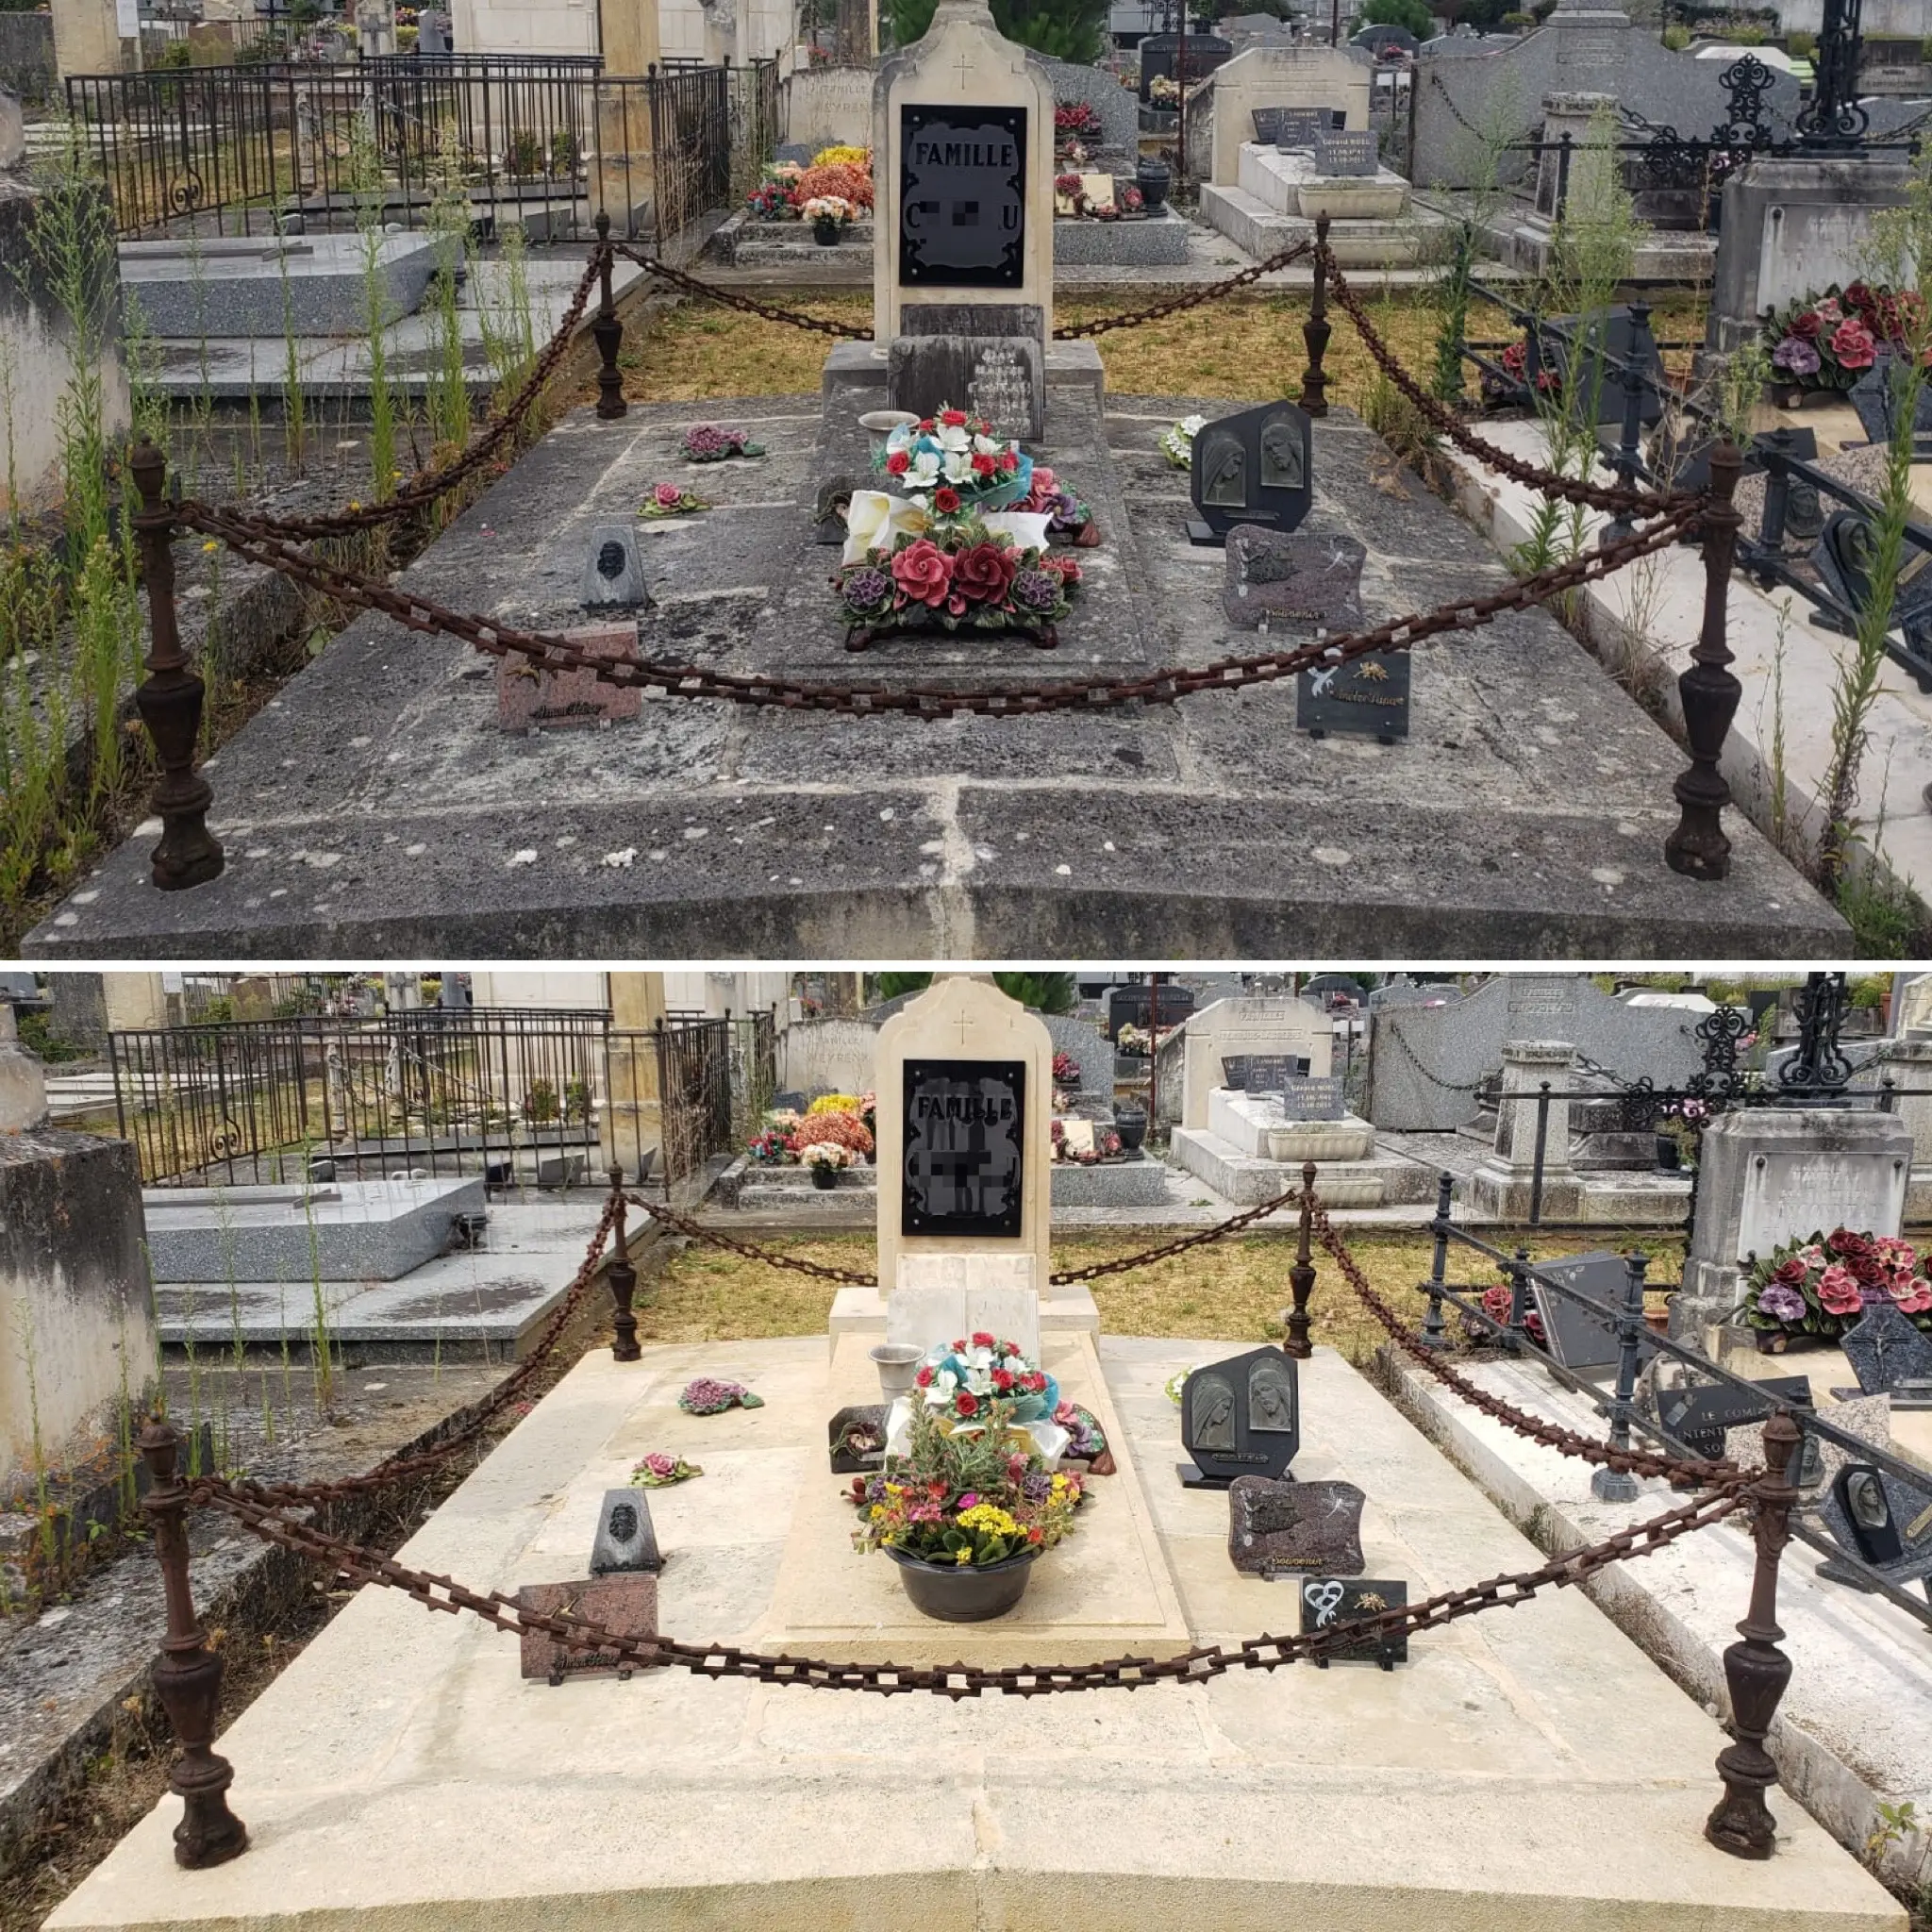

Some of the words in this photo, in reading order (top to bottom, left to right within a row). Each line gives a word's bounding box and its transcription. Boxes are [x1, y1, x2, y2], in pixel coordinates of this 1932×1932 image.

[915, 142, 1013, 167] FAMILLE
[1701, 1410, 1716, 1422] LE
[1703, 1442, 1725, 1455] SO
